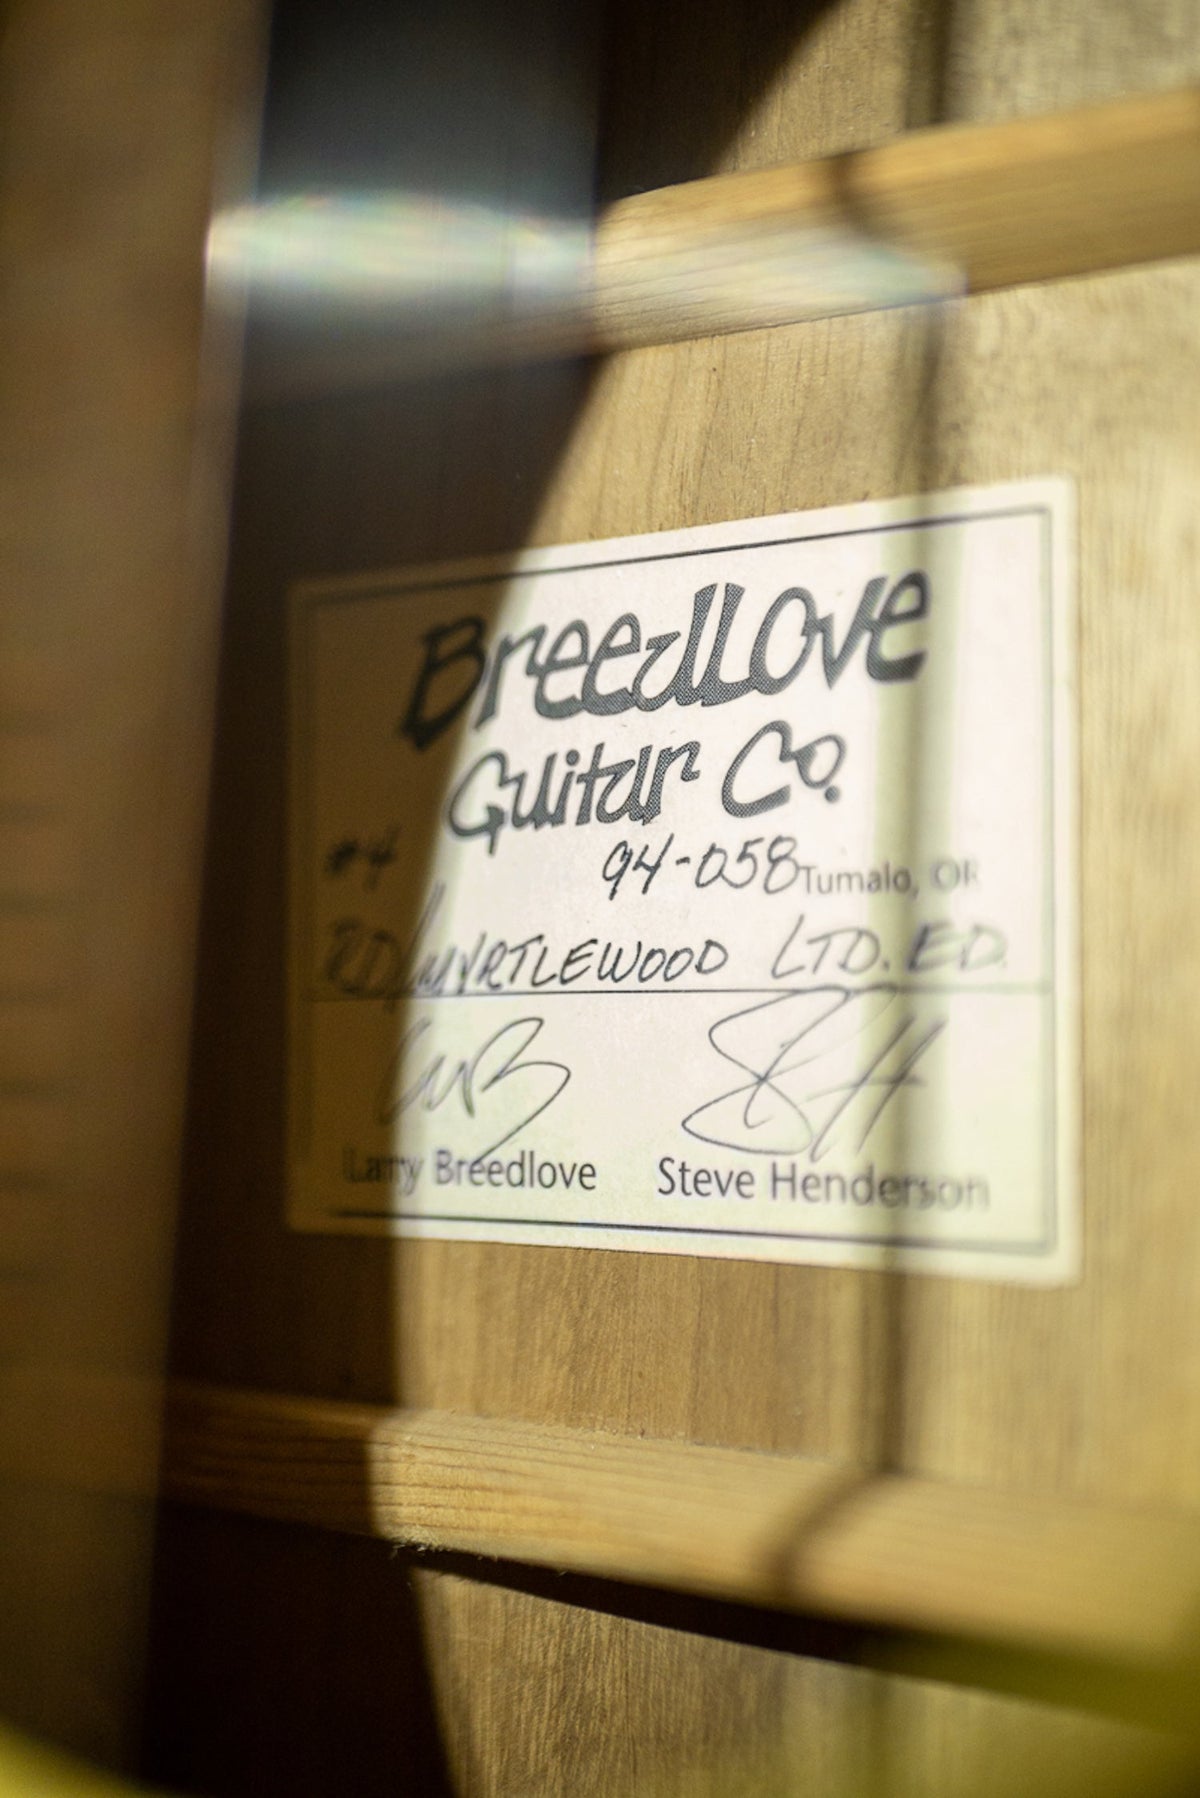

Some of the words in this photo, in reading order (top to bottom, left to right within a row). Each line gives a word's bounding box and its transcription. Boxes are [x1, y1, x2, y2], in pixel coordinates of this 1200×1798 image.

[401, 569, 931, 752] Breedlove
[449, 741, 701, 855] Guitar
[721, 719, 847, 819] Co.
[601, 834, 800, 900] 94-058
[801, 861, 921, 899] Tumalo,
[771, 914, 891, 980] LTD.
[342, 1147, 420, 1197] Larry
[436, 1146, 598, 1191] Breedlove
[657, 1156, 756, 1200] Steve
[770, 1161, 991, 1211] Henderson
